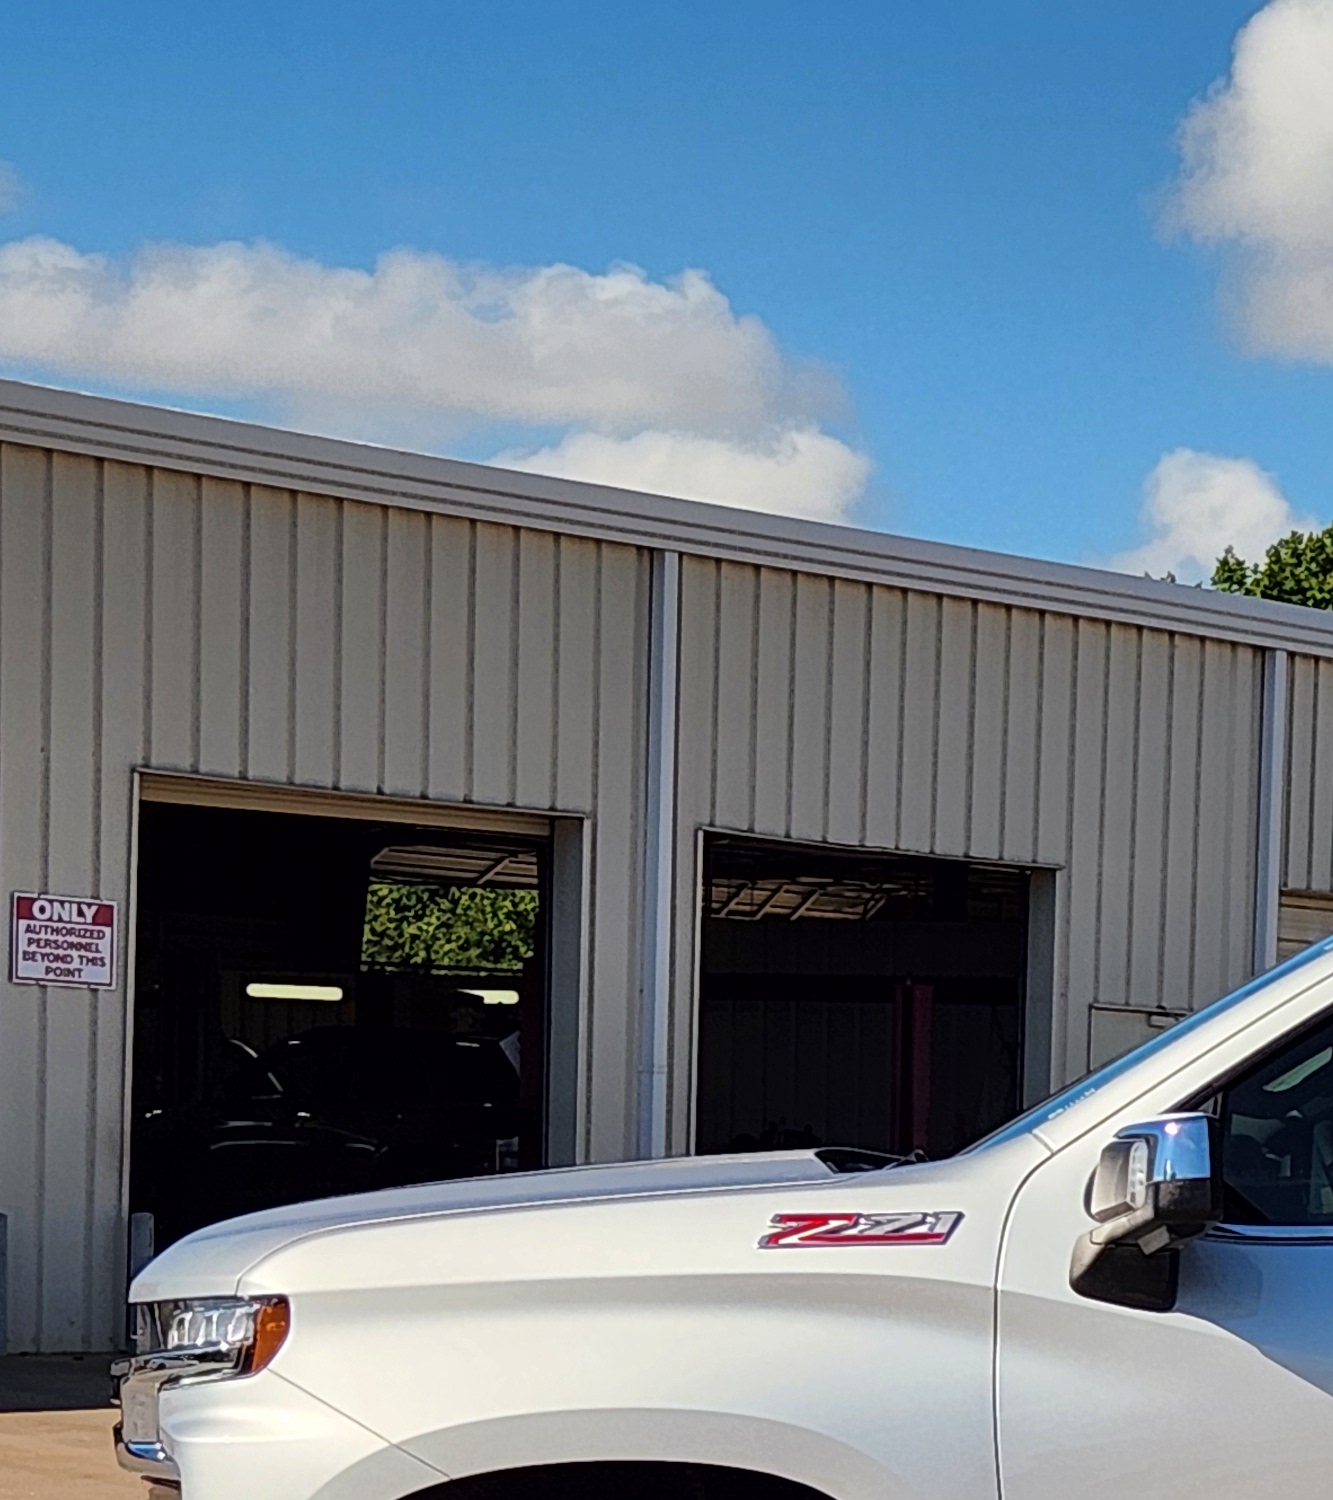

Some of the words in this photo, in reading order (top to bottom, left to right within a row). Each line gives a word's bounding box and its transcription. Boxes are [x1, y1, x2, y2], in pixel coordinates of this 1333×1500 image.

[31, 899, 99, 924] ONLY
[24, 923, 106, 940] AUTHORIZED
[27, 937, 102, 953] PERSONNEL
[22, 950, 74, 965] BEYOND
[77, 954, 106, 968] THIS
[44, 965, 84, 979] POINT
[757, 1211, 965, 1249] Z71
